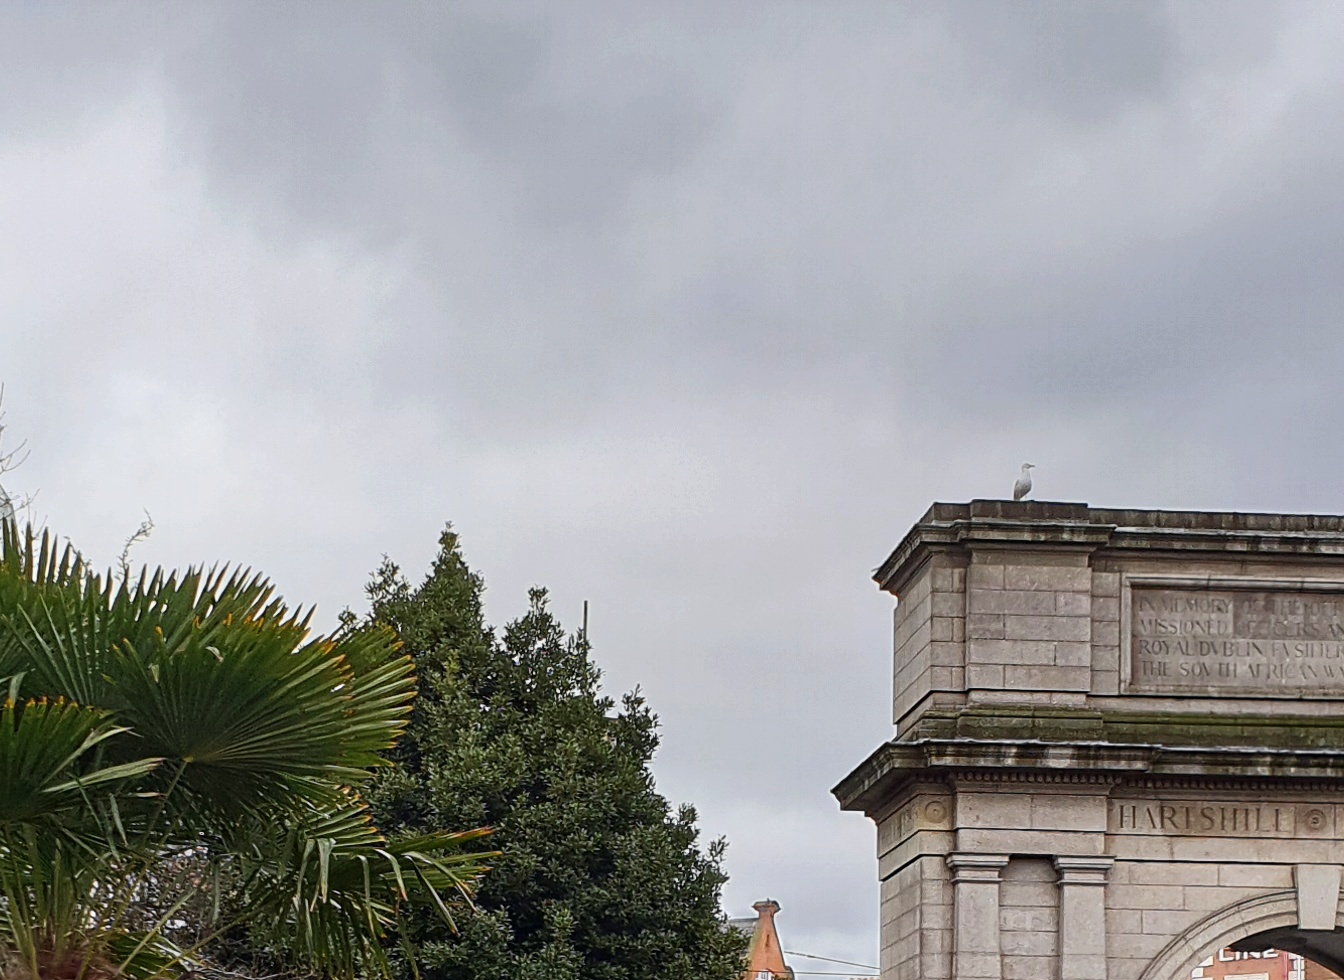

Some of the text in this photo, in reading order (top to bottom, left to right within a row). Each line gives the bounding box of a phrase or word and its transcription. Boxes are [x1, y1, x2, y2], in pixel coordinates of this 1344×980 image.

[1161, 597, 1233, 614] MEMORY
[1141, 618, 1229, 636] MISSIONED
[1139, 639, 1195, 656] ROYAL
[1141, 660, 1172, 678] THE
[1248, 662, 1318, 681] AFRICAN
[1118, 805, 1293, 834] HARTSHILL
